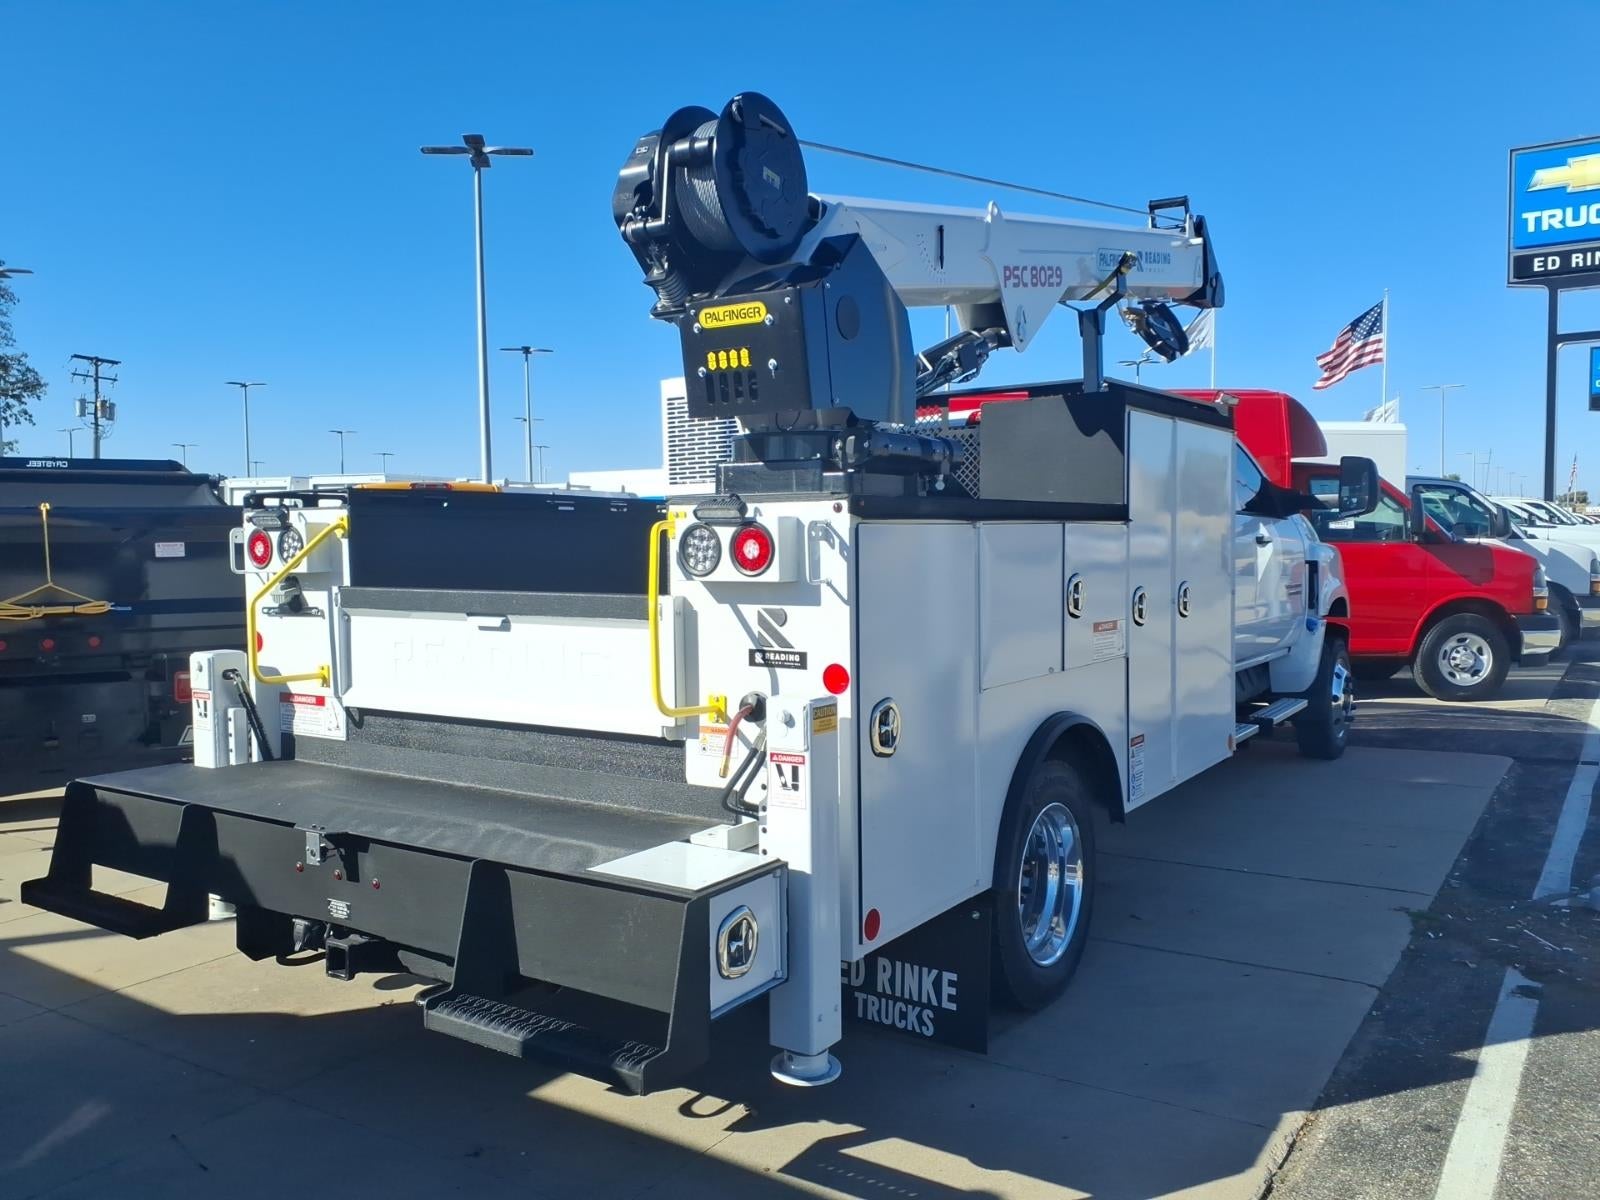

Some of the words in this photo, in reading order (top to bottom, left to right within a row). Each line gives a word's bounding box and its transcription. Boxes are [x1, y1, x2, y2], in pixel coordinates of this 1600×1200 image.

[1533, 256, 1560, 272] ED
[1003, 265, 1029, 288] PSC
[1030, 265, 1063, 288] 8029
[704, 306, 761, 325] PALFINGER
[765, 652, 800, 662] READING
[778, 755, 804, 763] DANGER
[877, 956, 957, 1011] RINKE
[854, 992, 934, 1037] TRUCKS
